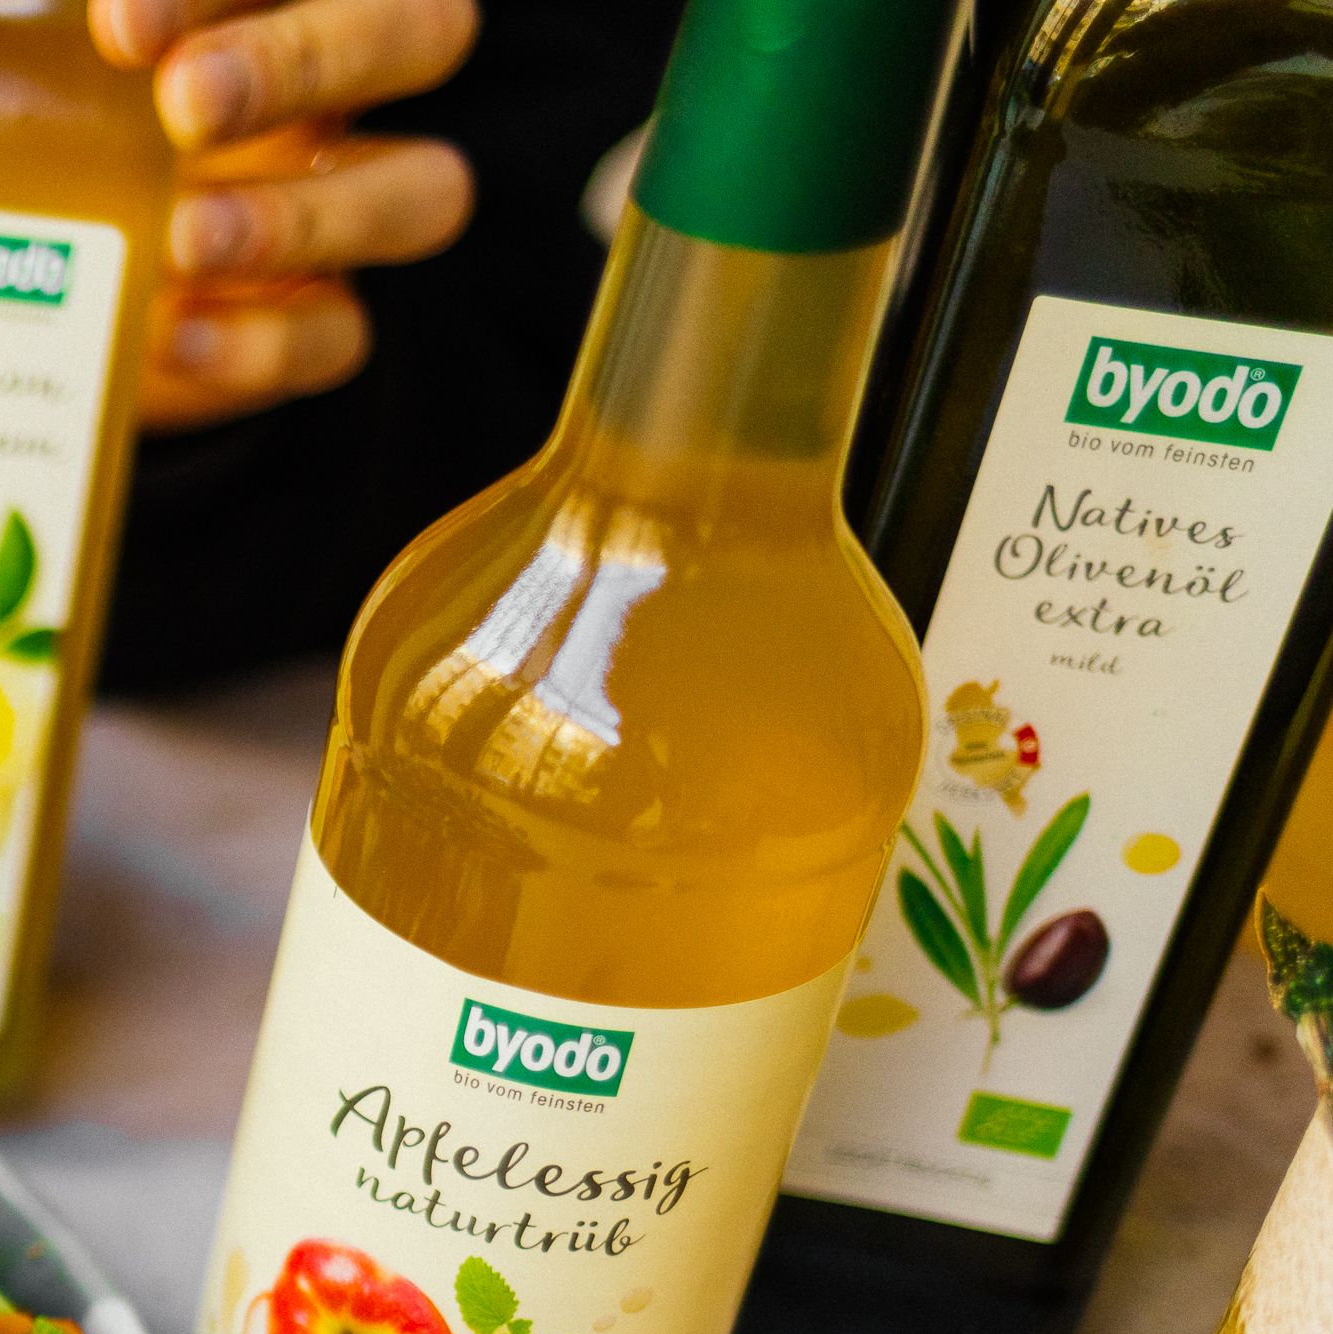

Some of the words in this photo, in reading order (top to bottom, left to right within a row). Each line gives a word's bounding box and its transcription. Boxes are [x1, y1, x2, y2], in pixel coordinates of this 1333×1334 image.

[1068, 430, 1102, 451] bio
[1111, 439, 1154, 458] vom
[1163, 444, 1255, 473] feinsten
[1031, 484, 1243, 549] Natives
[994, 533, 1248, 603] Olivenöl
[1035, 598, 1171, 638] extra
[1049, 652, 1122, 675] mild
[453, 1070, 480, 1089] bio
[487, 1081, 523, 1101] vom
[530, 1091, 606, 1114] feinsten
[330, 1085, 709, 1215] Apfelessig
[355, 1166, 646, 1256] naturtrüb
